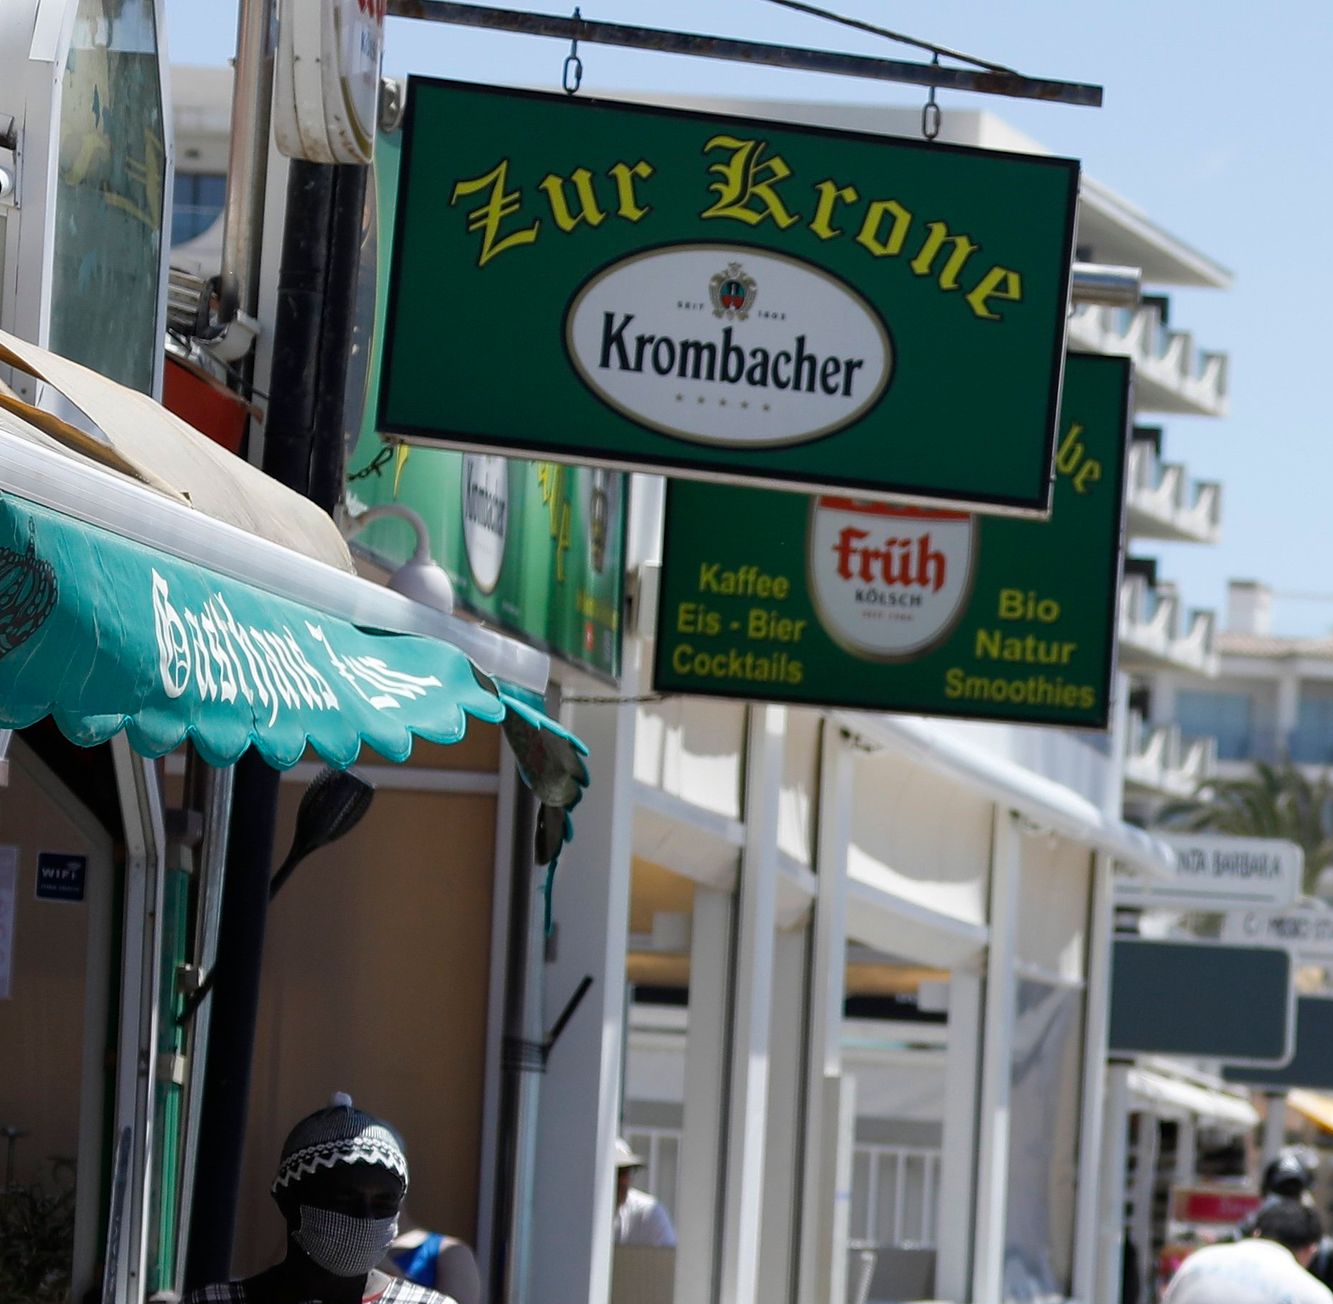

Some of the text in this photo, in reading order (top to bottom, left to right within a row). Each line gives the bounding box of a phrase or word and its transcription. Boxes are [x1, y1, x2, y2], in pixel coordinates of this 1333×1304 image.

[451, 135, 1024, 321] Zur Krone
[599, 311, 864, 397] Krombacher
[699, 562, 790, 600] Kaffee
[854, 587, 924, 609] KÖLSCH
[676, 603, 722, 636] Eis
[747, 608, 807, 642] Bier
[997, 588, 1061, 624] Bio
[671, 645, 805, 684] Cocktails
[975, 629, 1078, 665] Natur
[944, 667, 1097, 710] Smoothies
